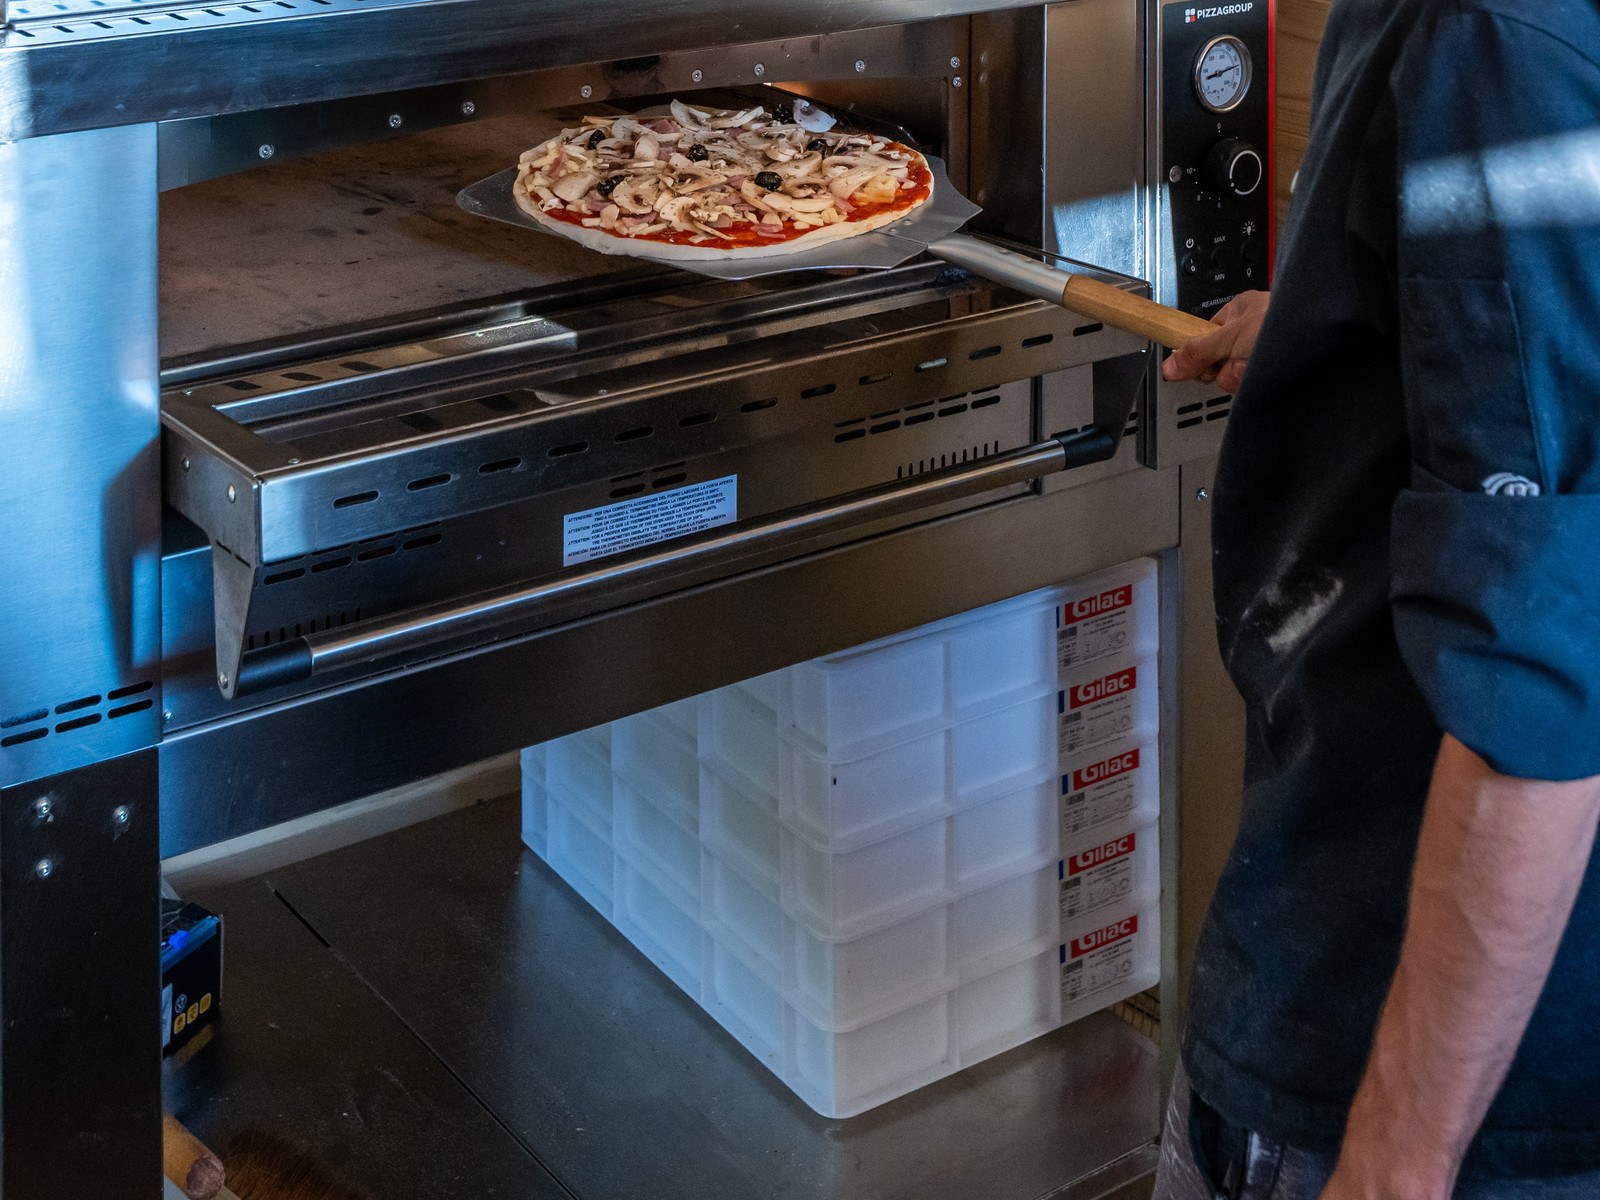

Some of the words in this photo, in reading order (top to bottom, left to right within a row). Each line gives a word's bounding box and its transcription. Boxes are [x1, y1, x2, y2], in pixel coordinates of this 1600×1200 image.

[1196, 2, 1253, 19] PIZZAGROUP
[1213, 236, 1226, 244] MAX
[1072, 590, 1125, 618] Gilac
[1077, 674, 1129, 702] Gilac
[1081, 754, 1133, 783] Gilac
